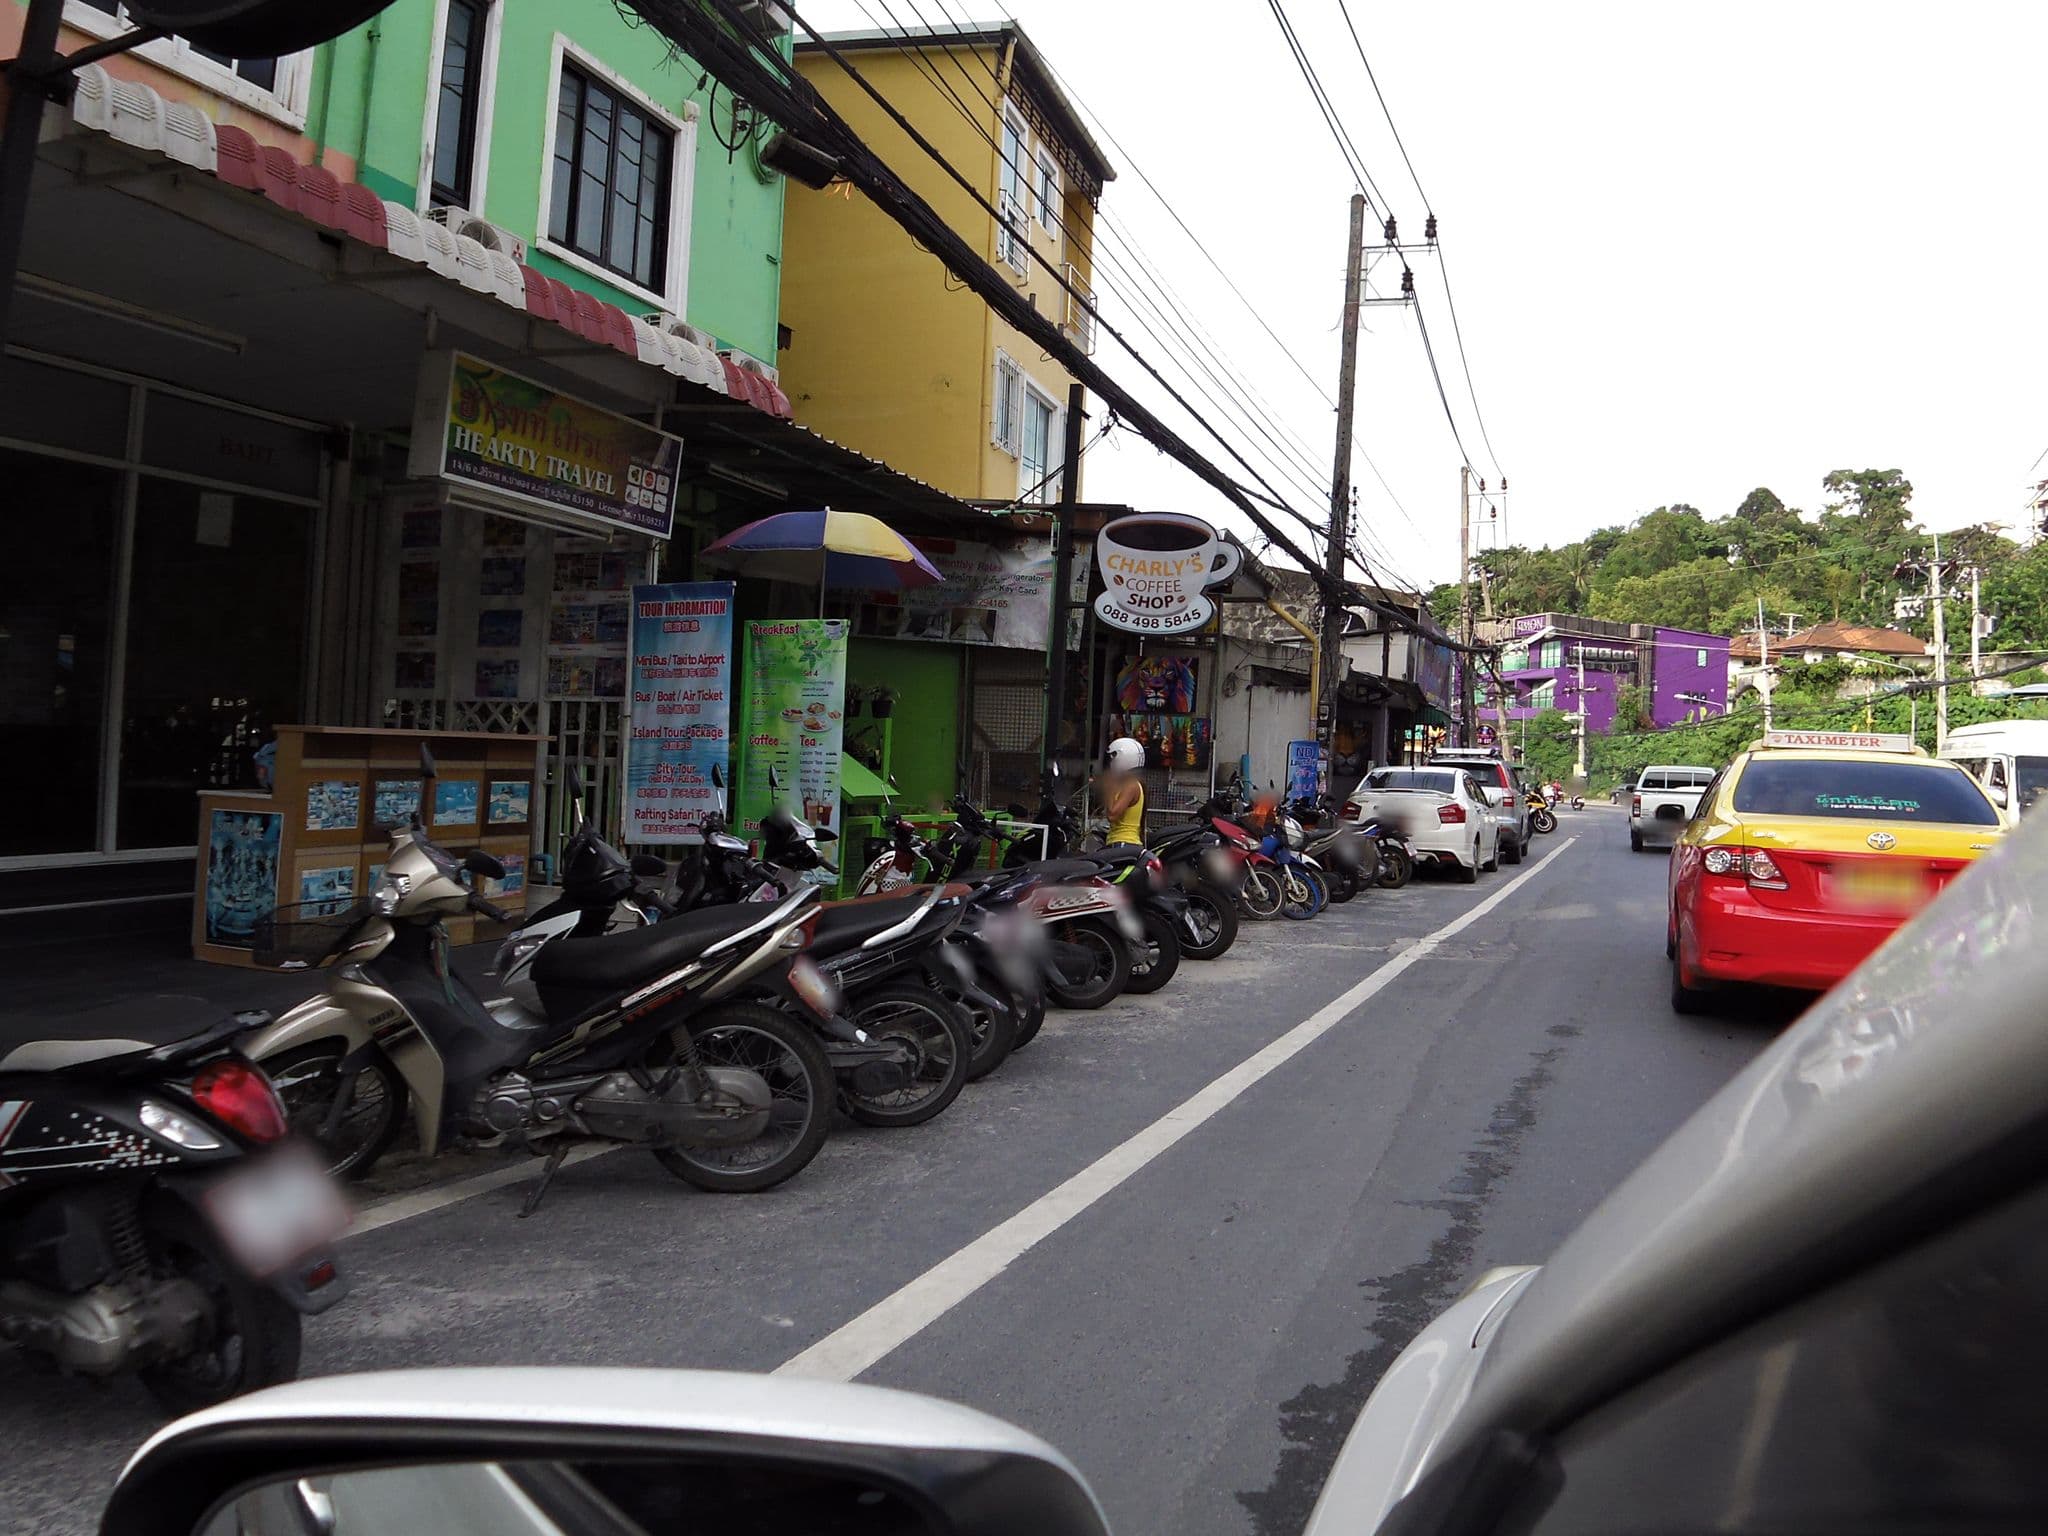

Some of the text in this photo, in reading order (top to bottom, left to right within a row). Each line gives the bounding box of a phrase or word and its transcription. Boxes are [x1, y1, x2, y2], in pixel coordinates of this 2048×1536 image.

[454, 426, 541, 473] HEARTY
[546, 456, 616, 495] TRAVEL
[1106, 553, 1205, 577] CHARLY'S
[1126, 578, 1182, 593] COFFEE
[640, 599, 727, 617] TOUR INFORMATION
[1127, 593, 1174, 609] SHOP
[1102, 604, 1201, 629] 088 498 5845
[698, 653, 725, 667] Airport
[635, 691, 650, 702] Bus
[657, 690, 676, 702] Boat
[682, 689, 697, 701] Air
[697, 688, 723, 701] Ticket
[633, 726, 723, 740] Island Tour Package
[800, 734, 816, 746] Tea
[749, 735, 779, 746] Coffee
[1784, 734, 1881, 747] TAXI-METER
[656, 764, 696, 776] City Tour
[634, 808, 666, 822] Rafting
[668, 808, 694, 820] Safari
